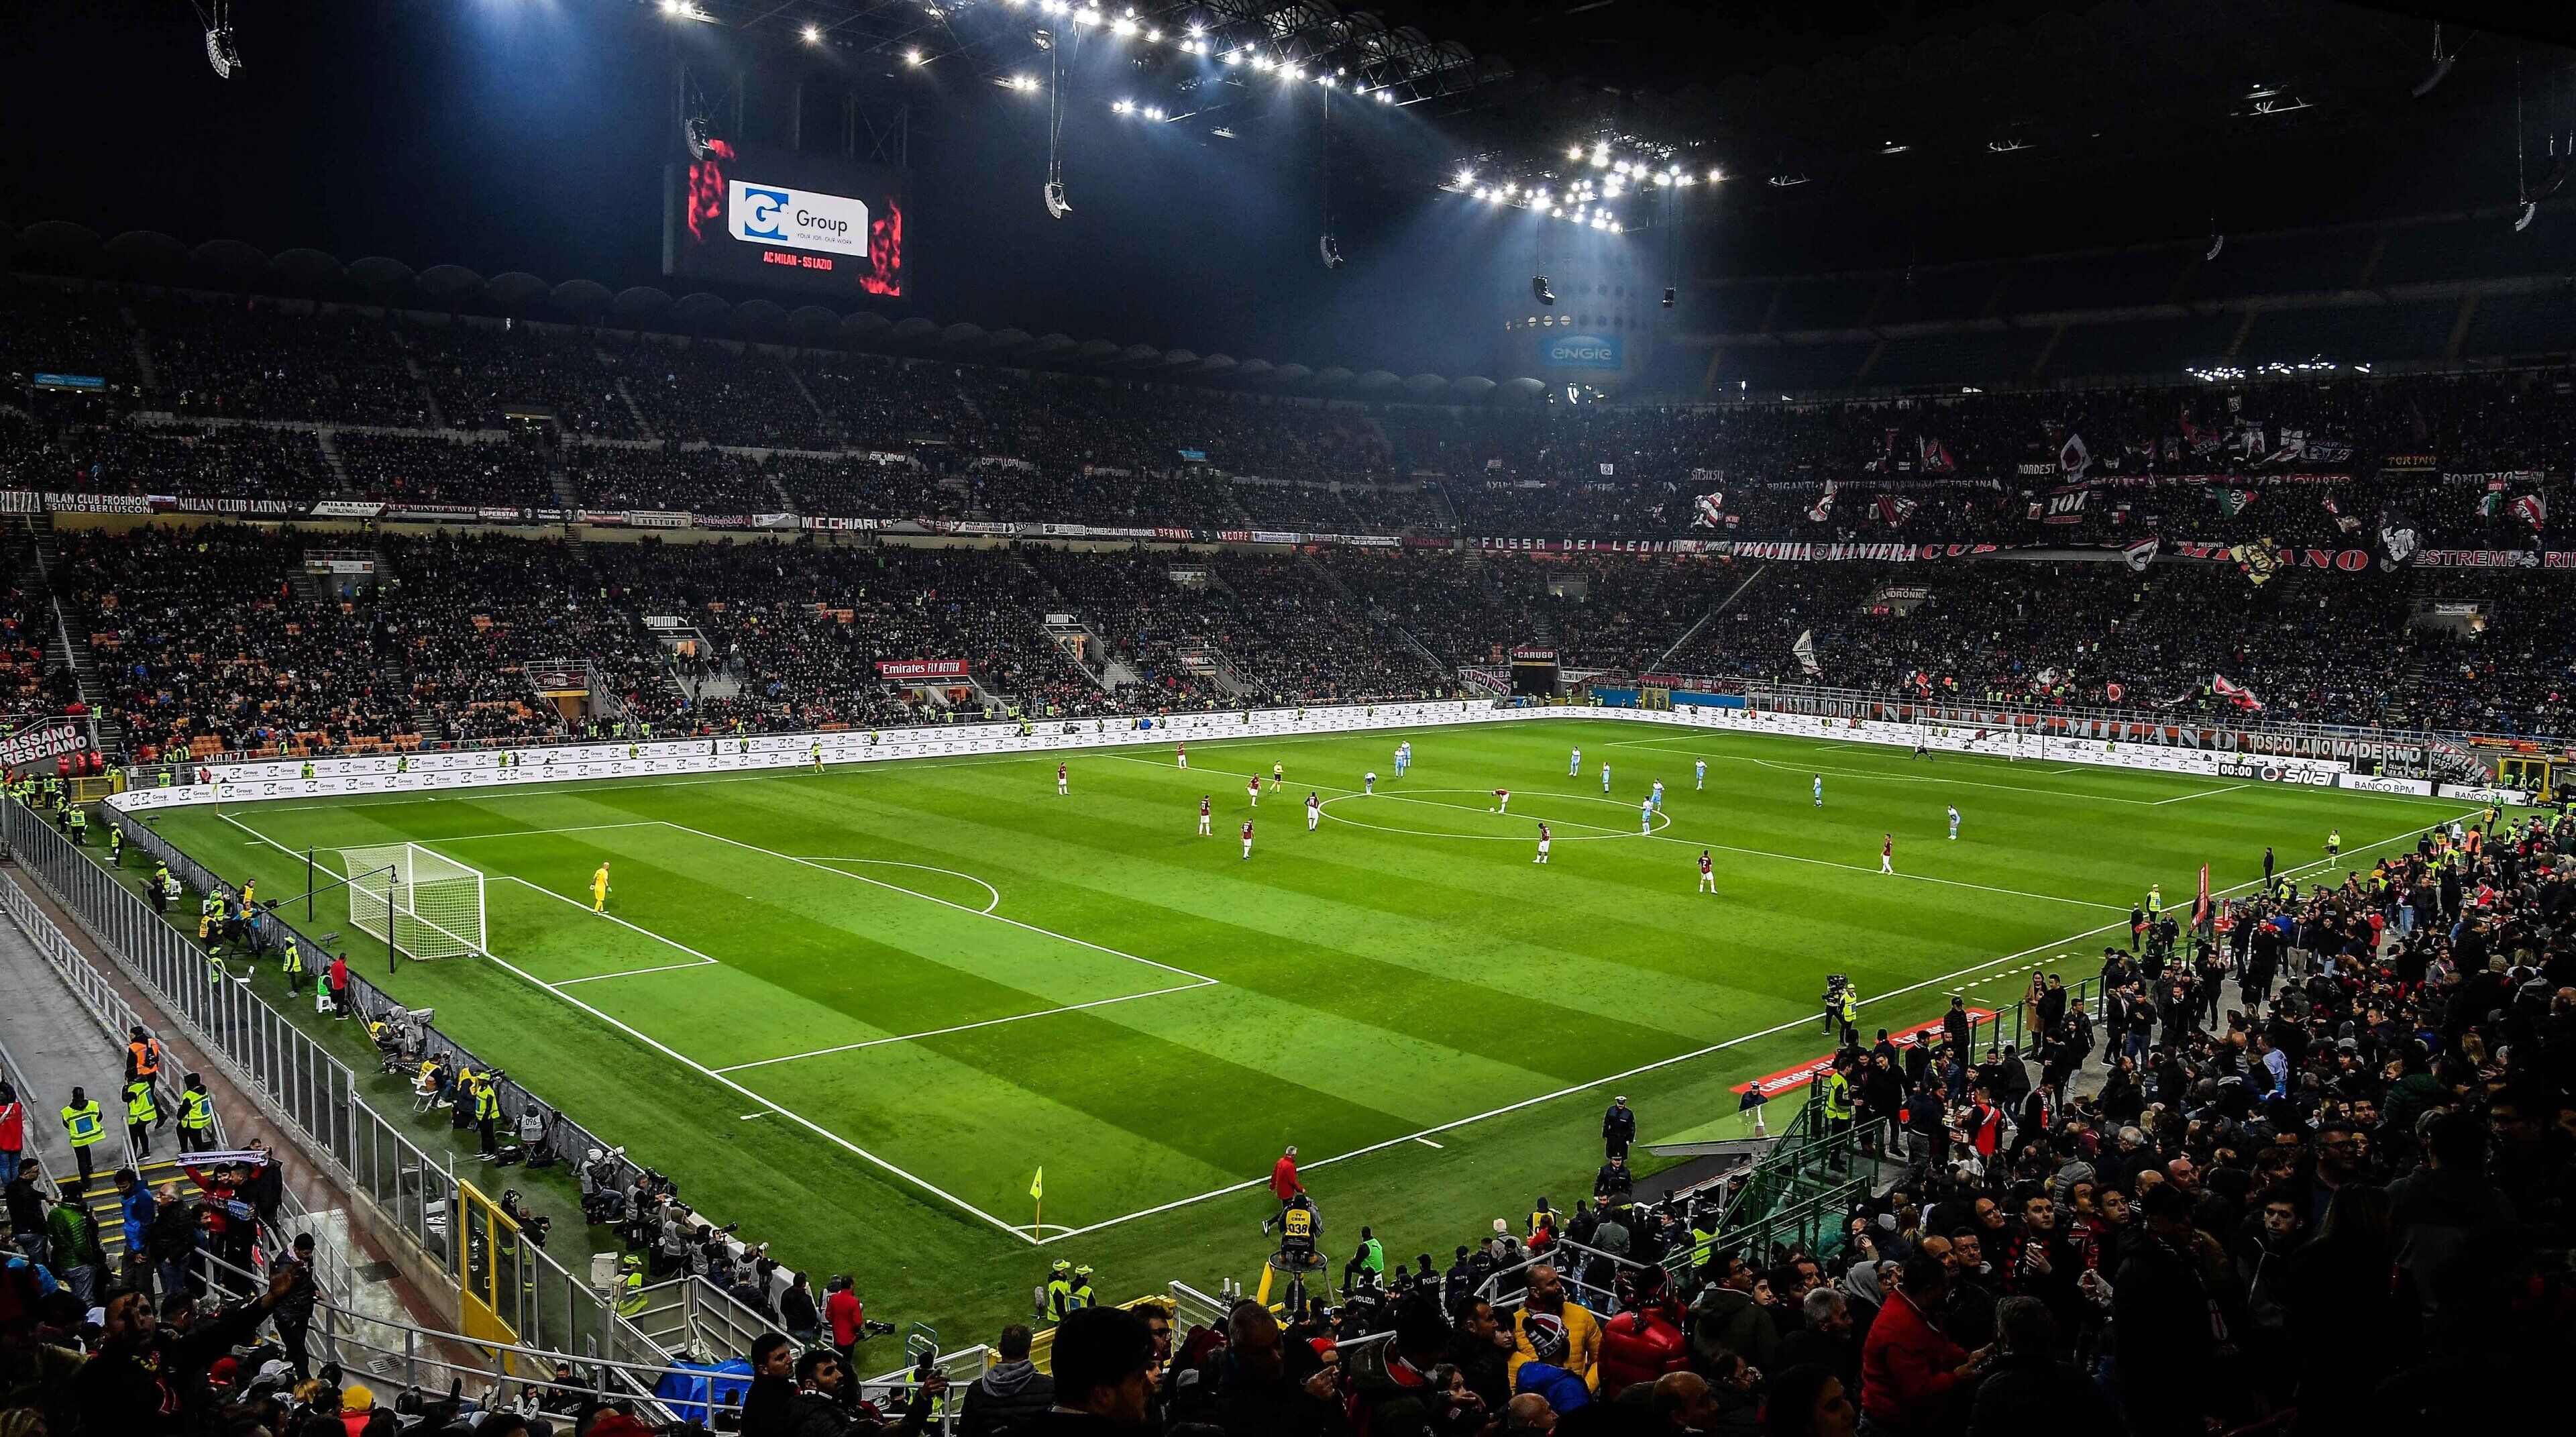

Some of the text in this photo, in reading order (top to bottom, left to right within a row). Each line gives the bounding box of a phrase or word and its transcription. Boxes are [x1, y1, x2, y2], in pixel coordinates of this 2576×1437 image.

[796, 209, 848, 236] Group
[763, 251, 773, 262] AC
[774, 253, 797, 266] MILAN
[803, 256, 812, 268] SS
[813, 258, 833, 270] LAZIO
[2018, 464, 2056, 474] NORDEST
[44, 493, 74, 504] MILAN
[77, 494, 100, 504] CLUB
[52, 503, 85, 512] SILVIO
[179, 498, 287, 513] MILAN CLUB LATINA
[409, 504, 476, 514] MONTECAVOLO
[478, 510, 519, 518] SUPERSTAR
[1085, 527, 1128, 536] COMMERCIALISTI
[1481, 537, 1672, 552] FOSSA DEI LEONI
[1733, 541, 1811, 561] VECCHIA
[1827, 543, 1915, 562] MANIERA
[647, 617, 678, 627] PUMA
[1046, 614, 1069, 624] PUMA
[882, 662, 960, 674] Emirates FLY BETTER
[0, 725, 76, 754] BASSANO
[204, 751, 249, 764] MONZA
[2220, 764, 2252, 777] 00:00
[2355, 781, 2414, 794] BANCO BPM
[193, 790, 209, 798] Group
[2455, 791, 2489, 802] BANCO
[1288, 1223, 1307, 1234] 038
[1355, 1294, 1375, 1306] POLIZIA
